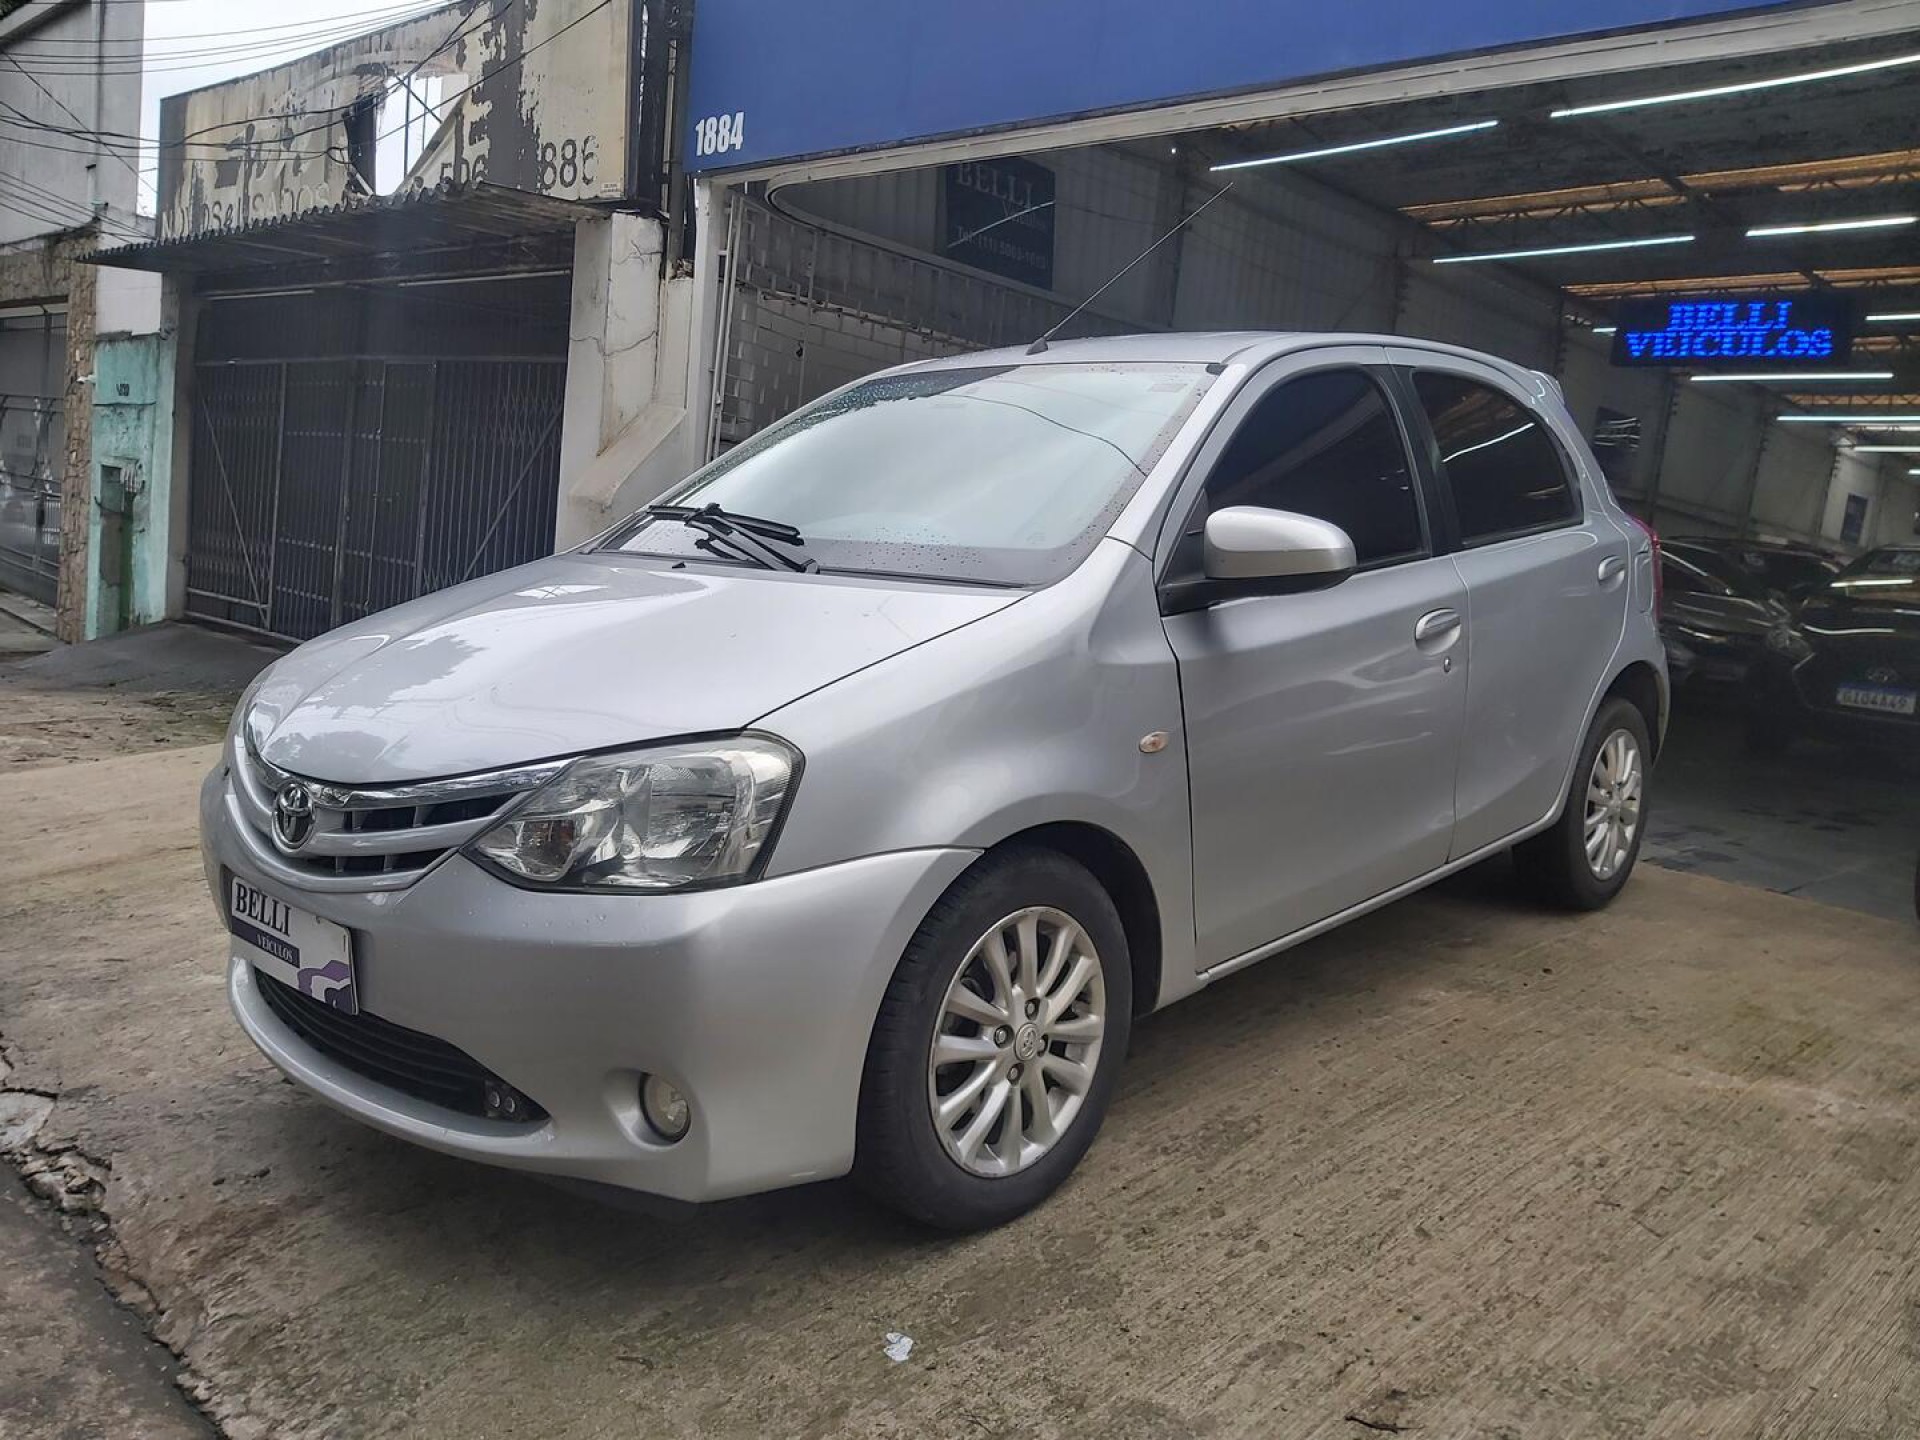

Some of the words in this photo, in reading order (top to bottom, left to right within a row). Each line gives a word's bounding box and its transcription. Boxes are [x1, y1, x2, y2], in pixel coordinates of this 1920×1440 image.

[695, 111, 745, 157] 1884
[957, 163, 1033, 209] BELLI
[1667, 301, 1792, 332] BELLI
[235, 882, 292, 937] BELLI
